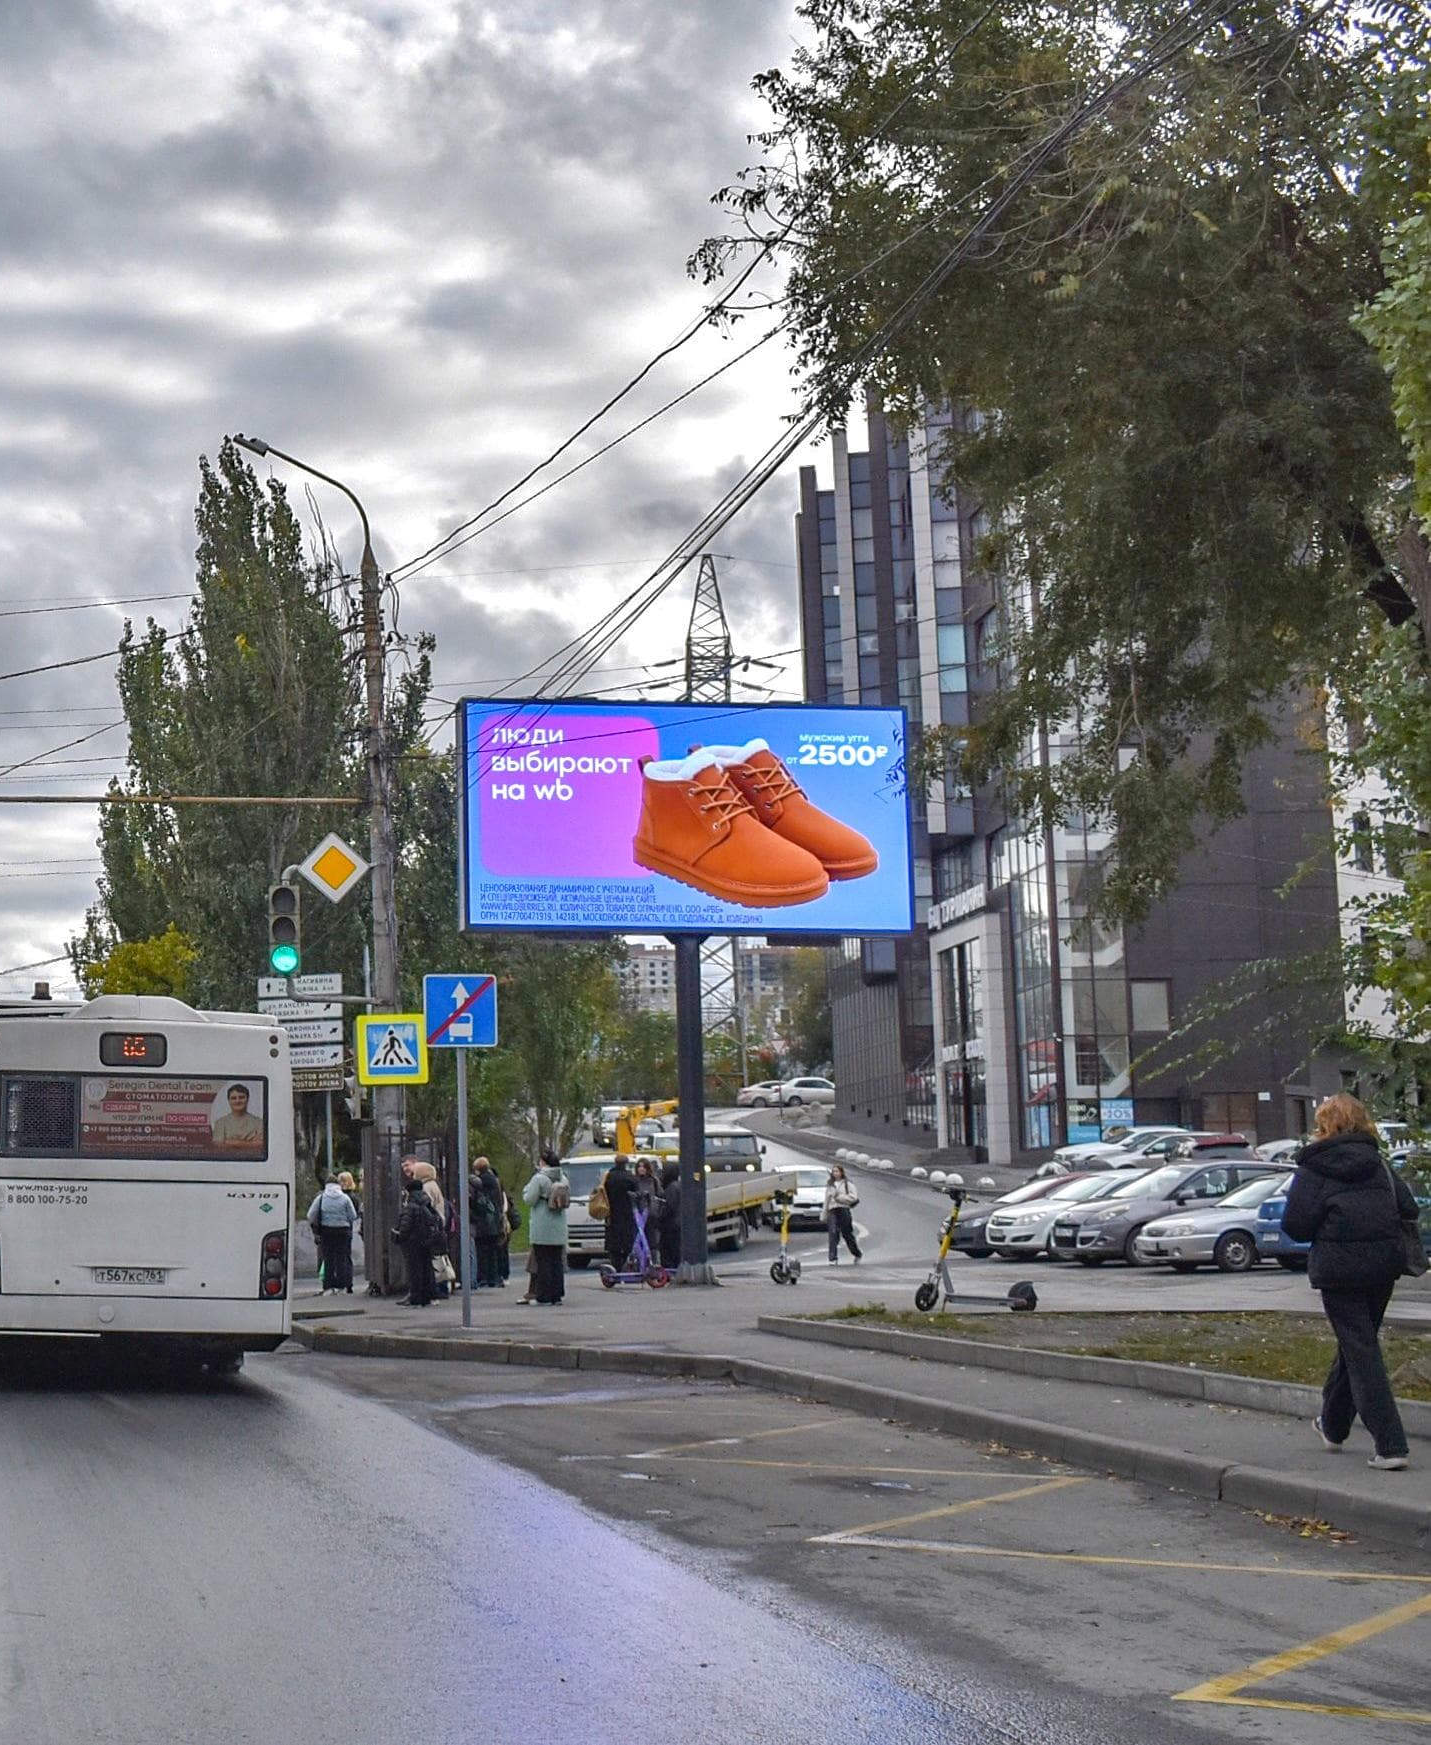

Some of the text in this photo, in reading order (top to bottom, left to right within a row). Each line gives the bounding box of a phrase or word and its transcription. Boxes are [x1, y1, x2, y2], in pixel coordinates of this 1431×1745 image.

[492, 728, 564, 748] люди
[799, 734, 869, 744] мужские угги
[491, 750, 633, 777] выбирают
[491, 778, 574, 801] на wb
[480, 883, 547, 893] ЦЕНООБРАЗОВАНИЕ
[549, 884, 595, 893] ДИНАМИЧНО
[631, 884, 655, 894] АКЦИЙ
[560, 903, 605, 912] КОЛИЧЕСТВО
[606, 904, 636, 912] ТОВАРОВ
[480, 912, 498, 920] ОГРН
[583, 913, 628, 921] МОСКОВСКАЯ
[109, 1080, 212, 1092] Seregin Dental Team
[125, 1092, 195, 1101] СТОМАТОЛОГИЯ
[7, 1184, 88, 1193] www.maz-yug.ru
[7, 1194, 88, 1205] 8 800 100-75-20
